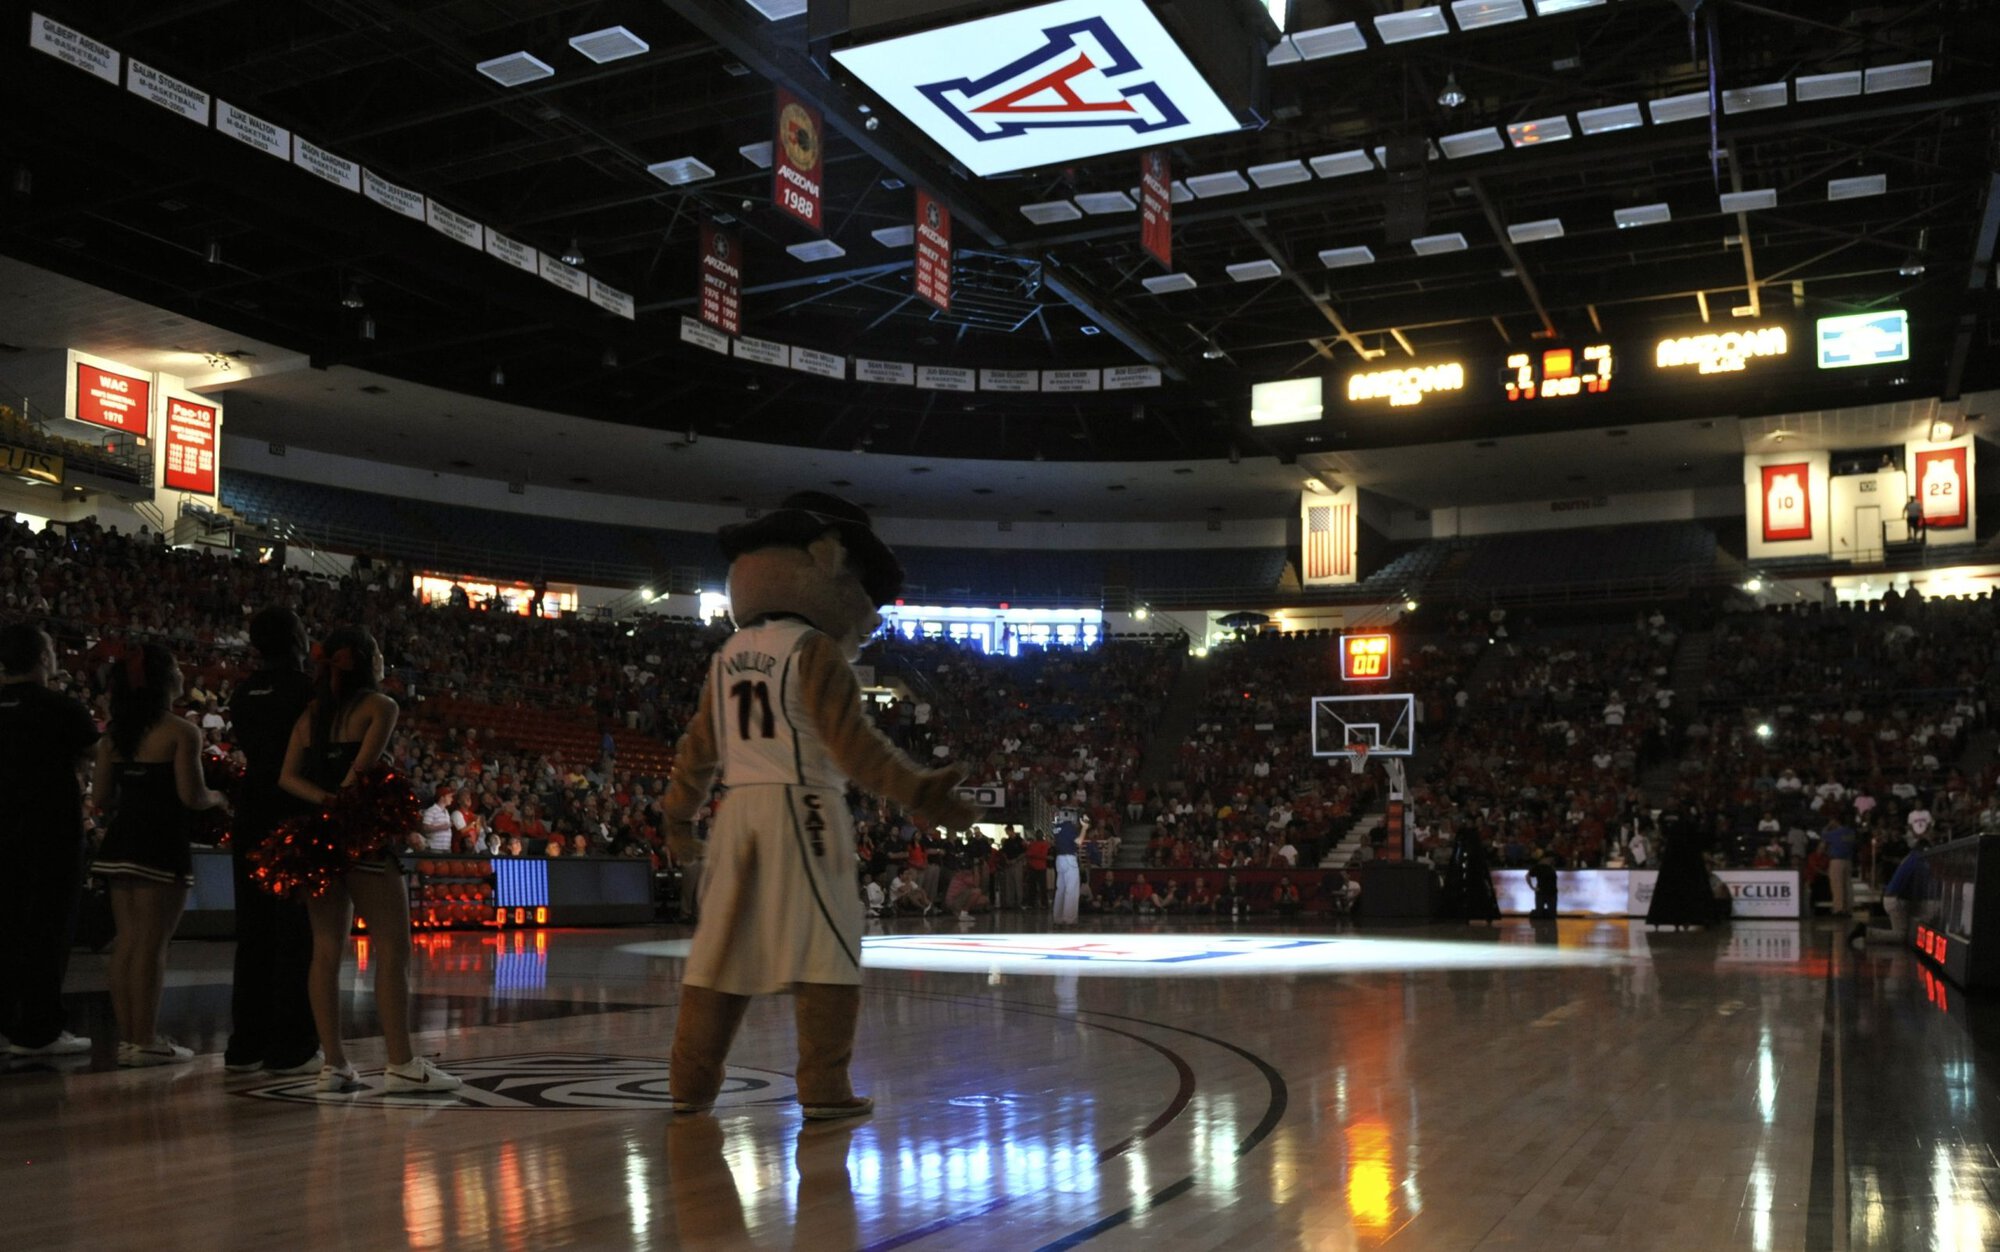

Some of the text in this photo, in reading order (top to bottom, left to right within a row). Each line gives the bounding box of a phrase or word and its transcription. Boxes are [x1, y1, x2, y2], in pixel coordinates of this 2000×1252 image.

[43, 20, 110, 60] GILBERT ARENAS
[45, 33, 108, 68] M-BASKETBALL
[133, 62, 206, 105] SALIM STOUDAMIRE
[139, 78, 198, 111] M-BASKETBALL
[227, 117, 280, 147] M-BASKETBALL
[230, 108, 276, 136] LUKE WALTON
[301, 141, 352, 171] JASON GARDNER
[778, 164, 820, 198] ARIZONA
[388, 185, 423, 204] JEFFERSON
[784, 188, 814, 219] 1988
[918, 223, 949, 252] ARIZONA
[918, 242, 940, 262] SWEET
[703, 254, 739, 279] ARIZONA
[704, 309, 720, 323] 1994
[722, 306, 737, 320] 1991
[99, 375, 129, 393] WAC
[173, 403, 211, 422] Pac-10
[1928, 481, 1953, 496] 22
[1550, 499, 1591, 512] SOUTH
[1777, 496, 1794, 510] 10
[1353, 654, 1381, 674] 00
[731, 680, 775, 740] 11
